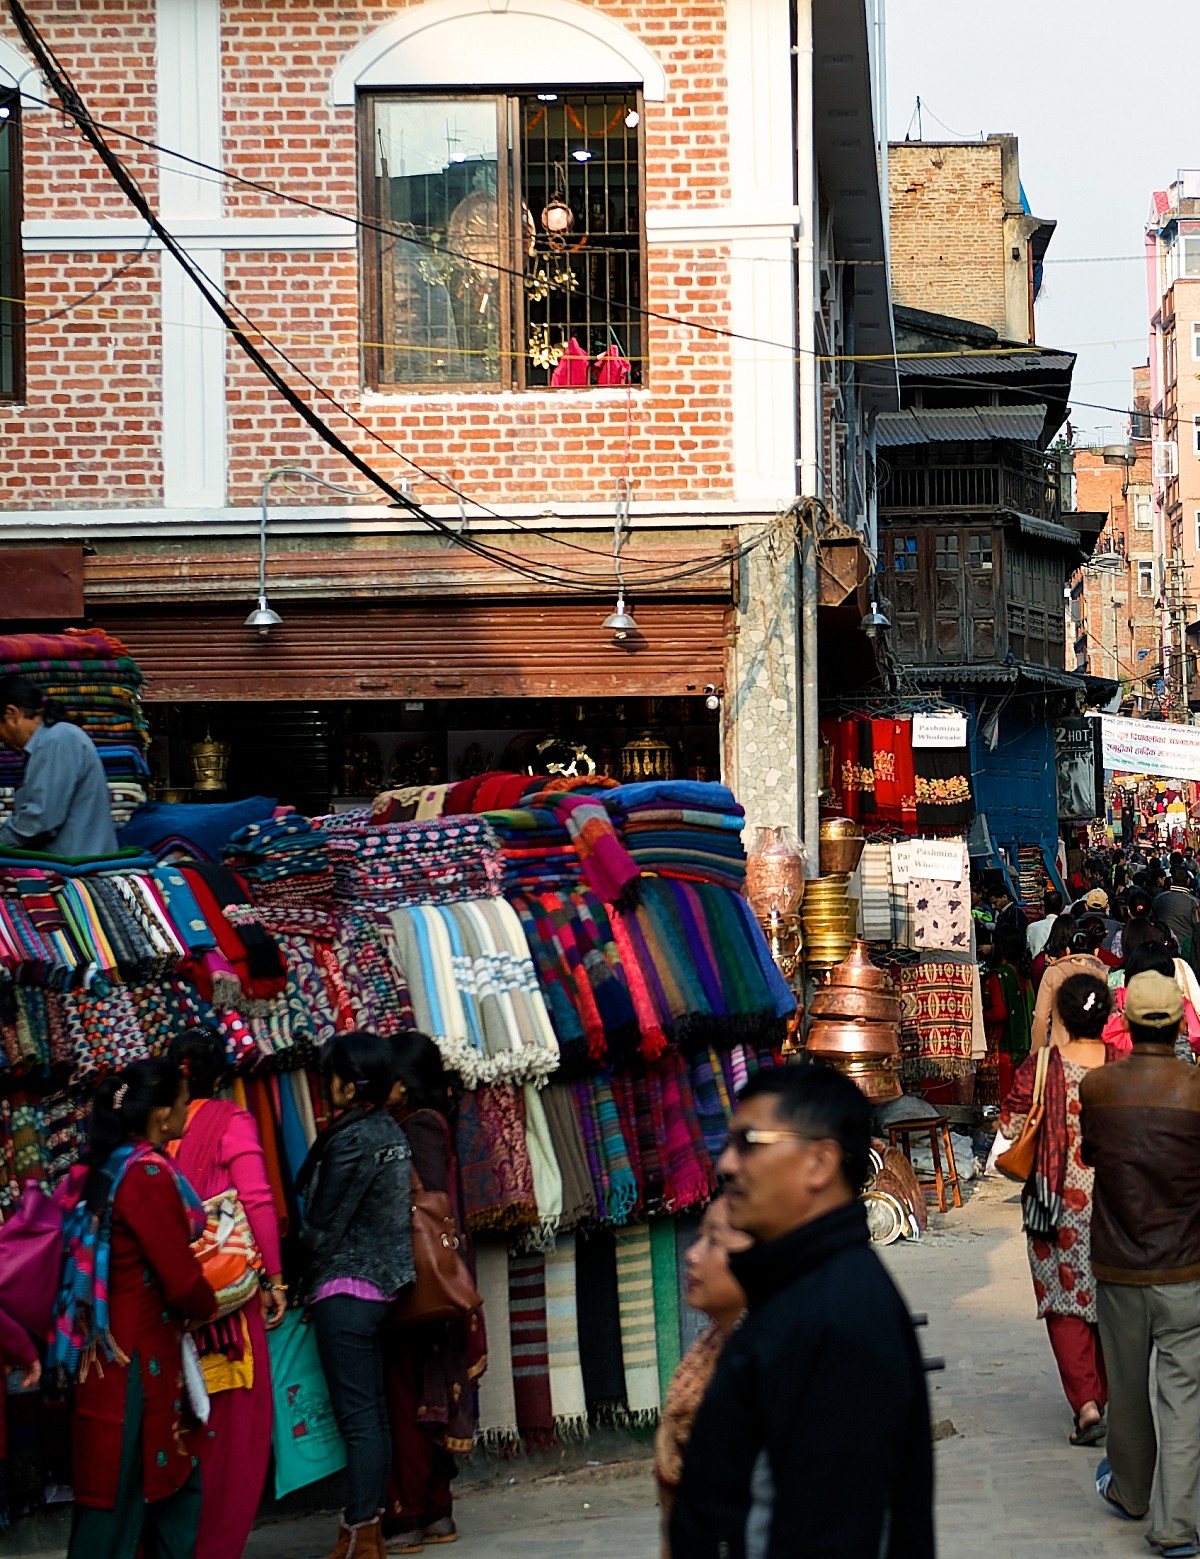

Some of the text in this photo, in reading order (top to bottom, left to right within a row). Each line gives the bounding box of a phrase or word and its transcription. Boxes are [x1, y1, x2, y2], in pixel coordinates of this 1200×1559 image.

[919, 724, 961, 732] Pashmina
[1055, 727, 1089, 742] 2 HOT
[916, 847, 958, 859] Pashmina
